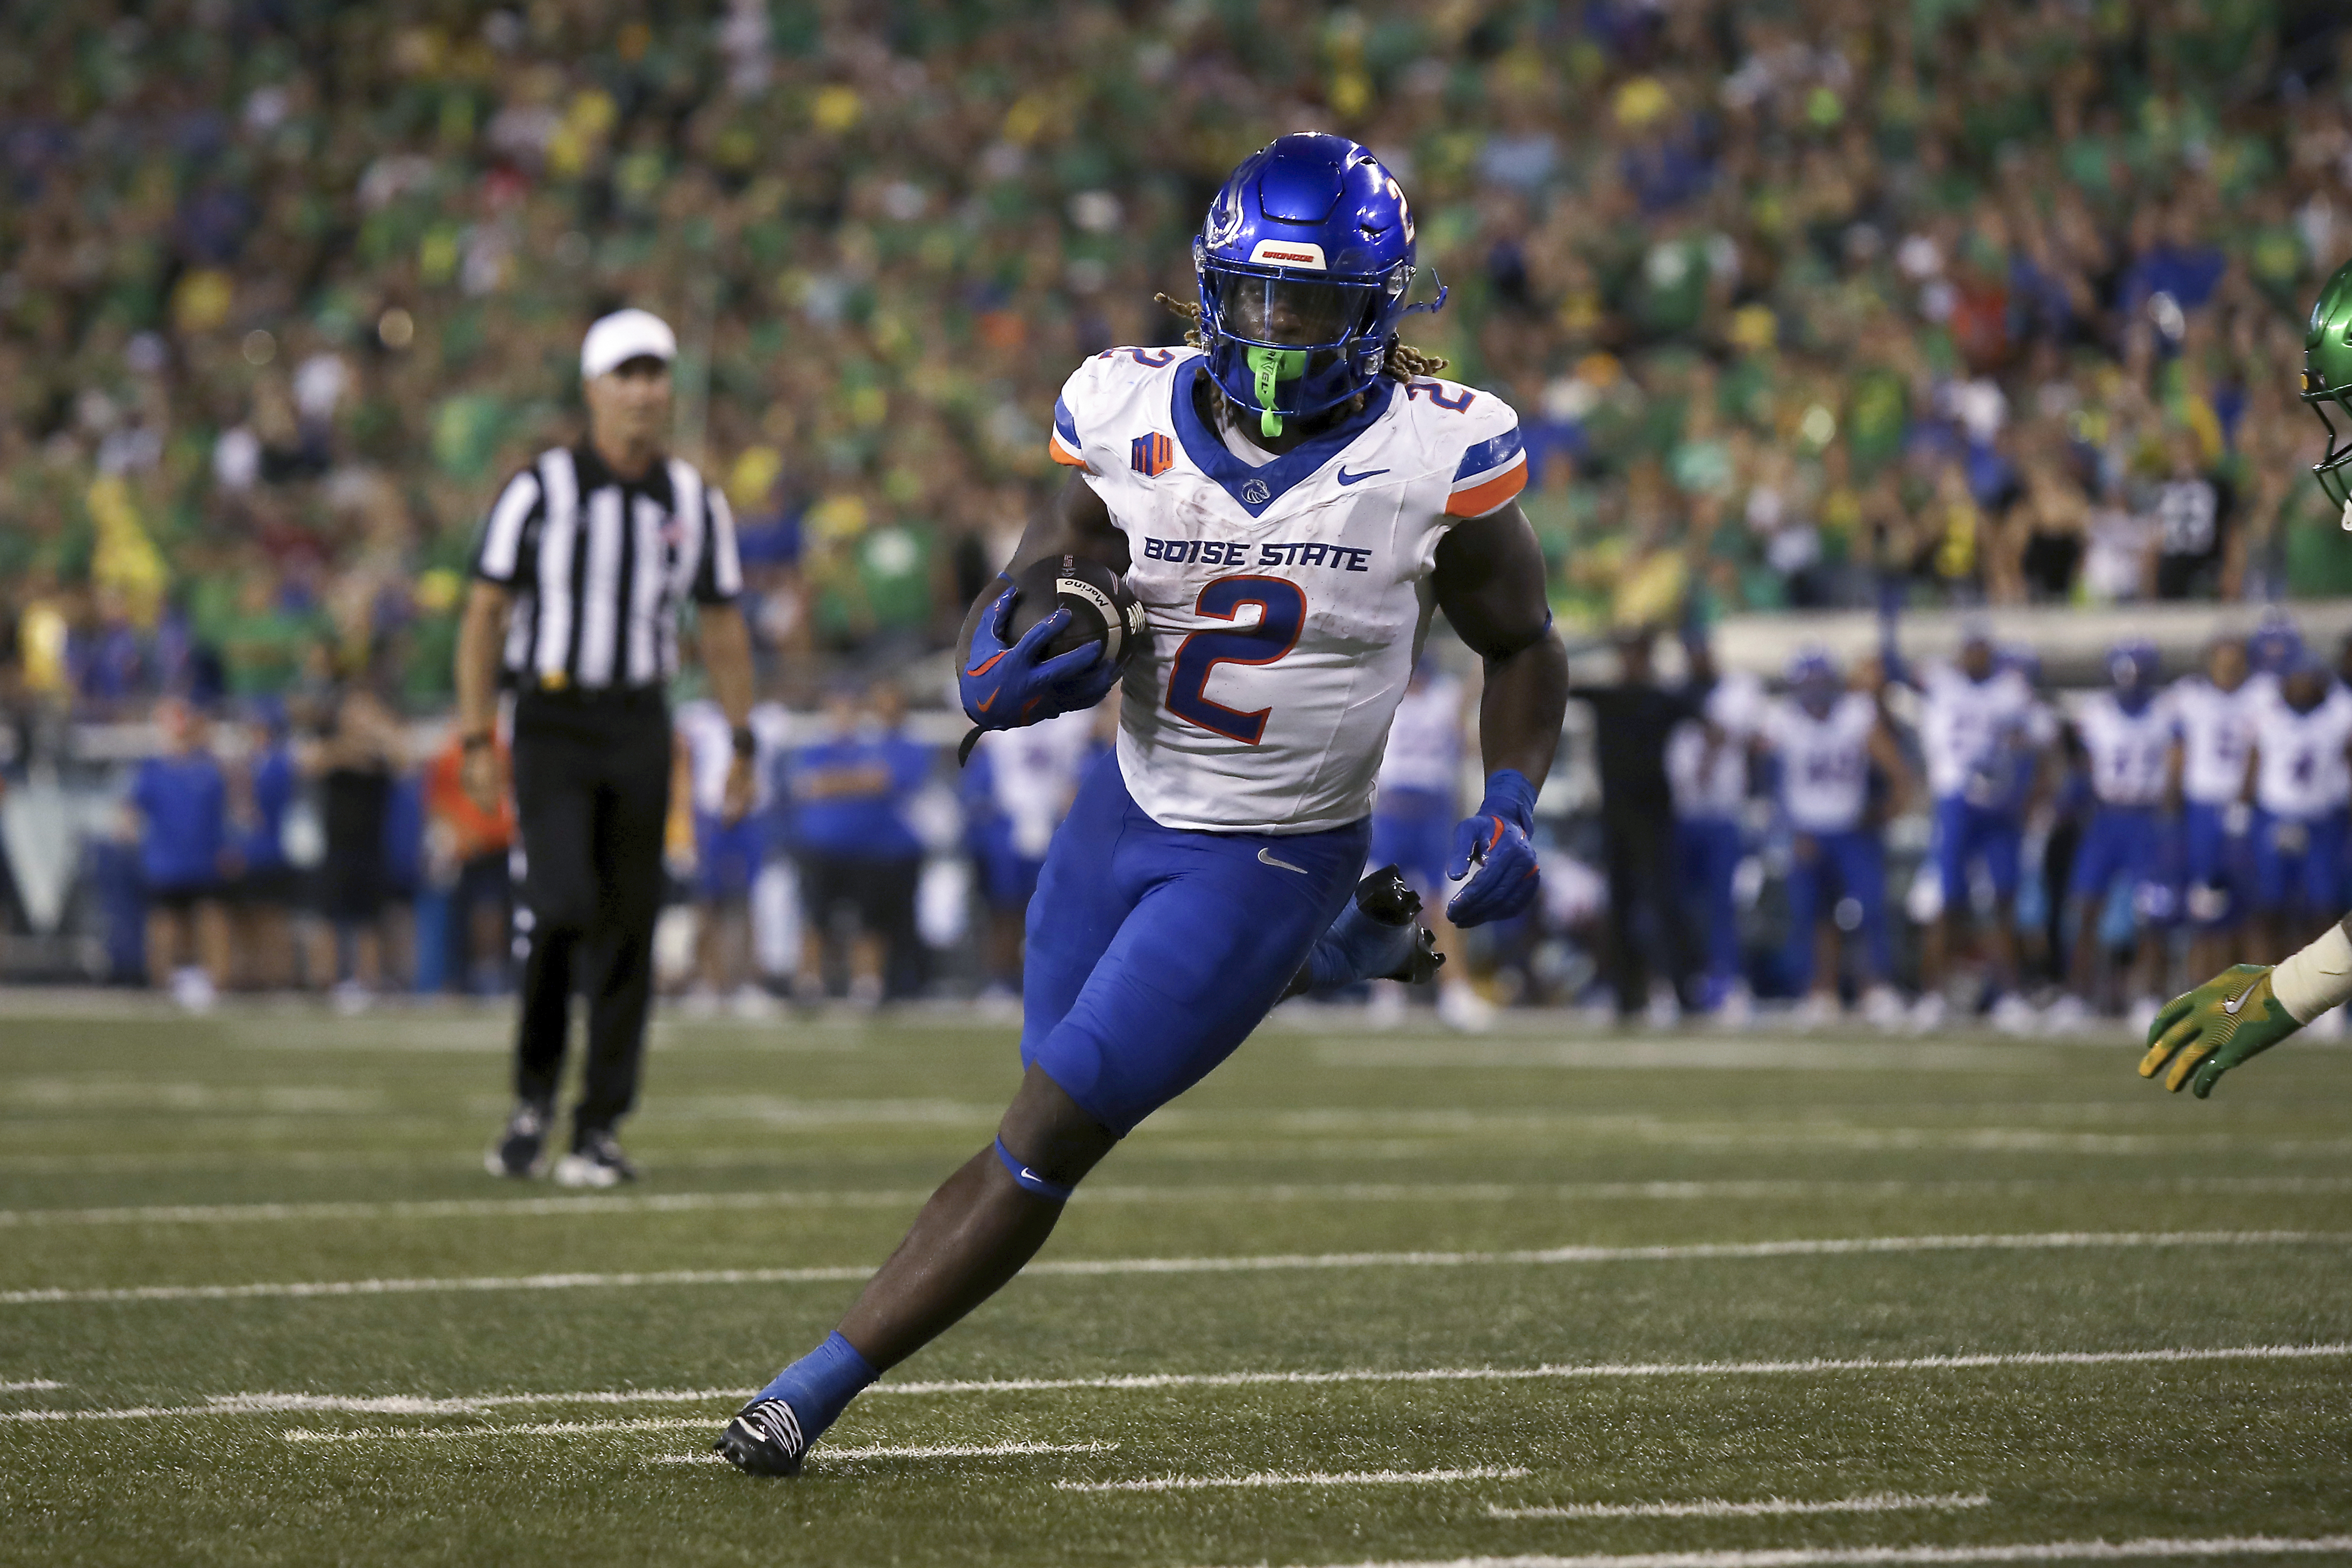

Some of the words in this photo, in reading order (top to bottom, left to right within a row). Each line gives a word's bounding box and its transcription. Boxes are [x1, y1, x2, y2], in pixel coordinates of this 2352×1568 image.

[1386, 177, 1416, 246] 2
[1262, 250, 1314, 262] BRONCOS
[1405, 382, 1476, 414] 2
[1144, 536, 1251, 565] BOISE
[1258, 543, 1372, 571] STATE
[1064, 580, 1109, 607] Marino
[1165, 574, 1307, 746] 2
